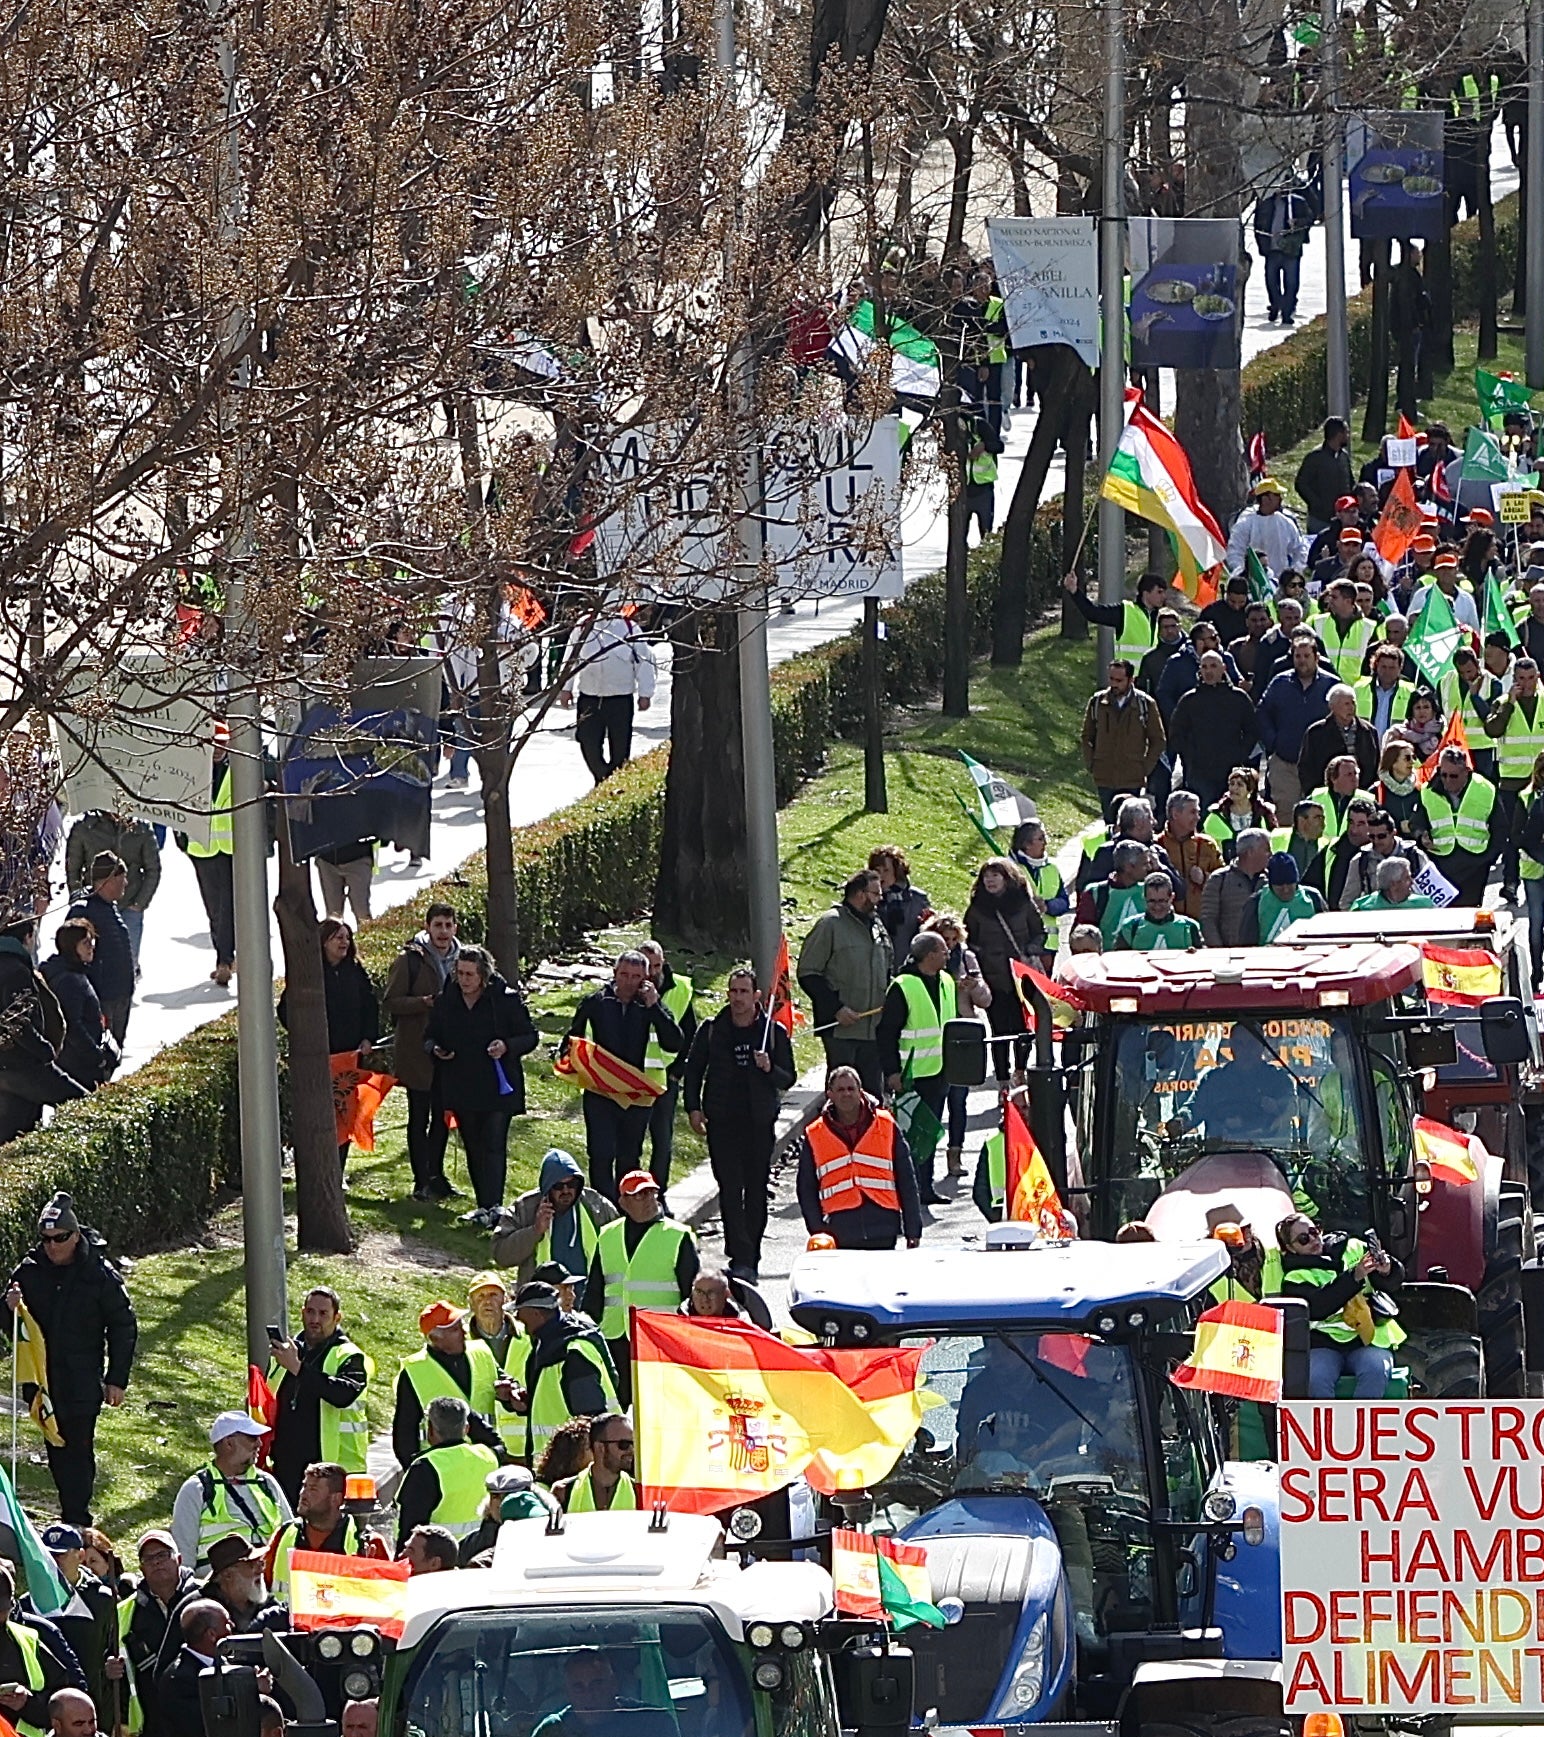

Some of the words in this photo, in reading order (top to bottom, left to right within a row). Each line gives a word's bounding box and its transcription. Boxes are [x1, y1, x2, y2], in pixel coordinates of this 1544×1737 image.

[819, 579, 869, 589] MADRID
[1416, 869, 1453, 907] Basta!
[1281, 1467, 1441, 1522] SERA
